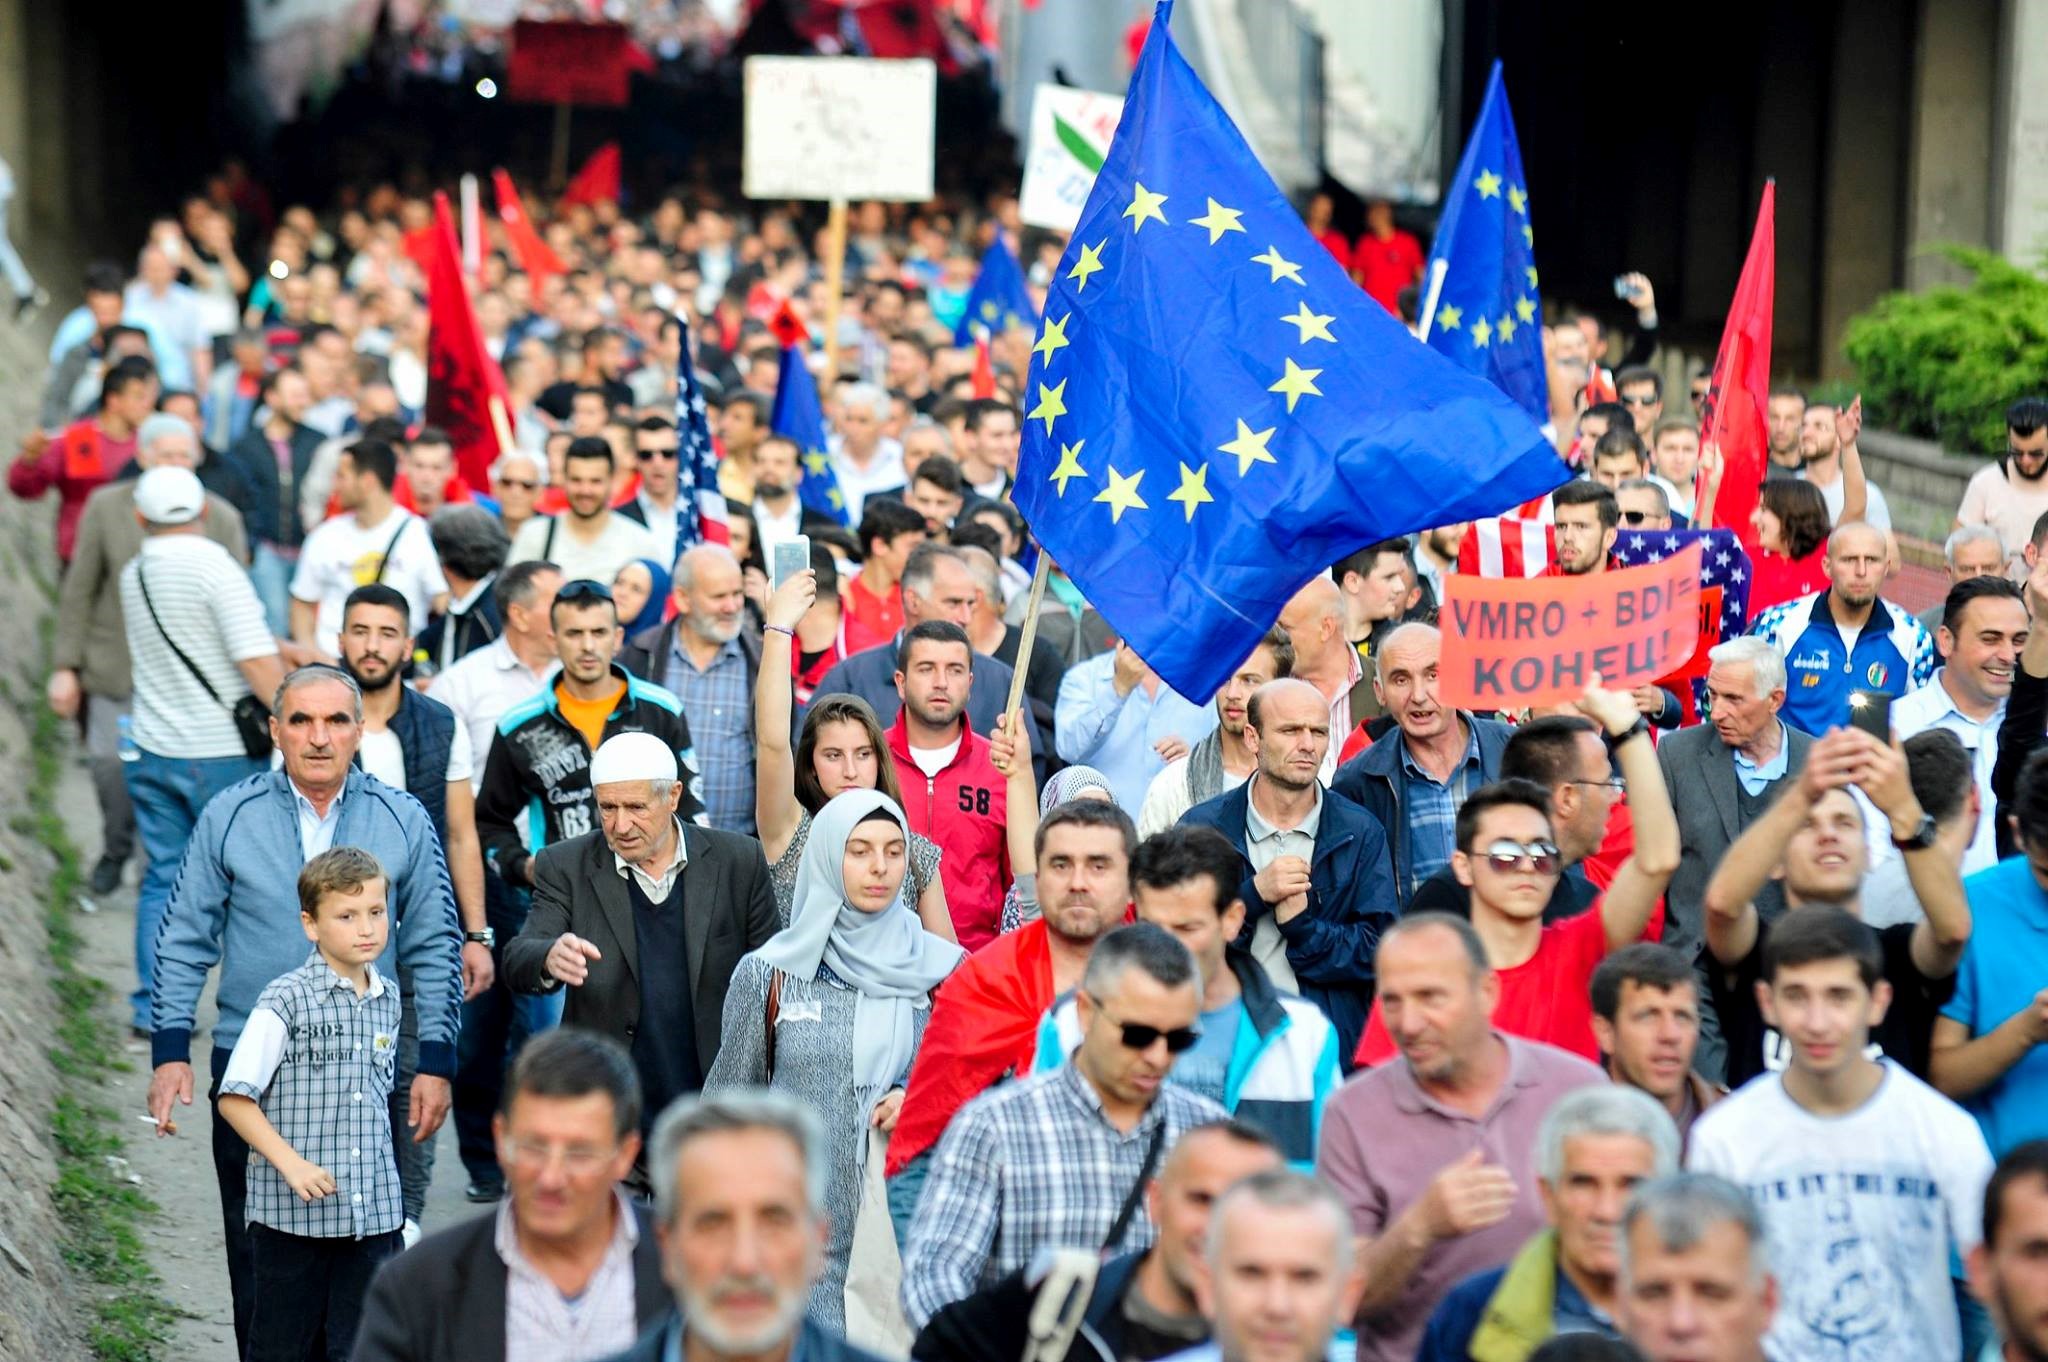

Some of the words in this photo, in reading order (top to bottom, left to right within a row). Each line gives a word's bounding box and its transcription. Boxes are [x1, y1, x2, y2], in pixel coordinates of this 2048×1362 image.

[1452, 599, 1565, 640] VMRO
[1473, 630, 1671, 696] КОНЕЦ!
[958, 785, 990, 816] 58
